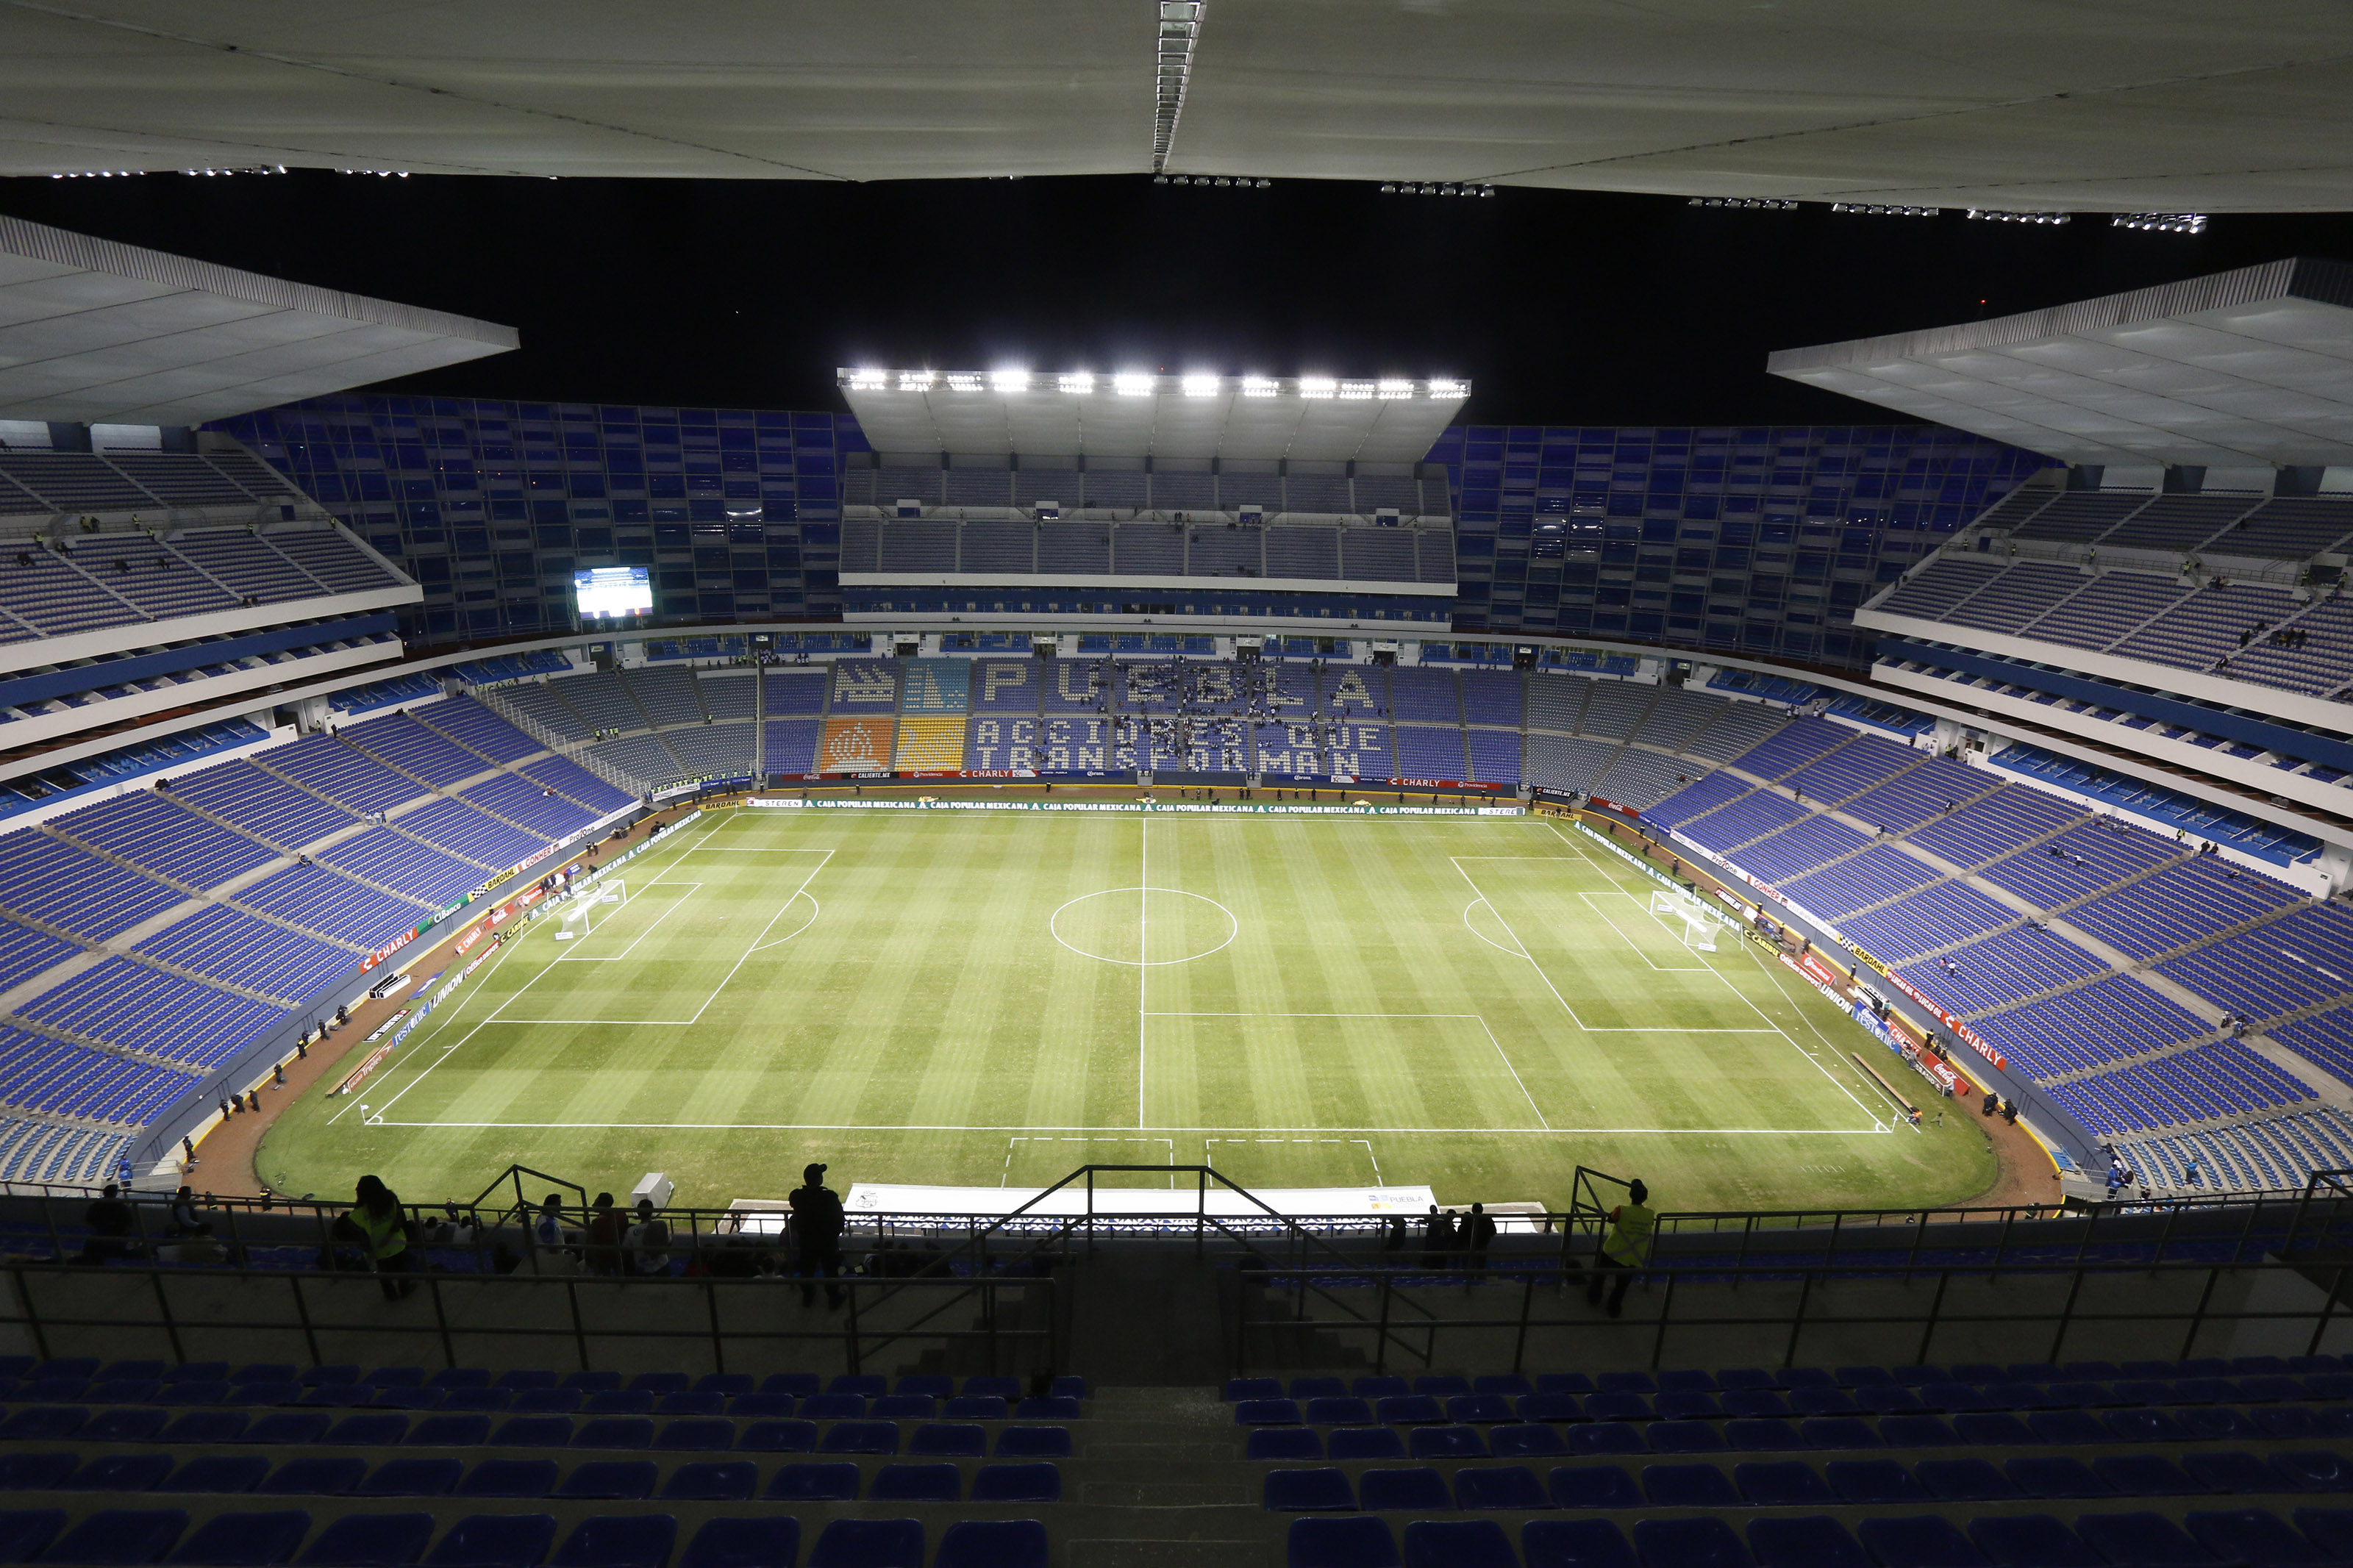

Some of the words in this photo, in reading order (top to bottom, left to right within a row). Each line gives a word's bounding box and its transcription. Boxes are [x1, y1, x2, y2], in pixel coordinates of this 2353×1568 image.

[985, 663, 1374, 708] PUEBLA
[1403, 778, 1440, 787] CHARLY
[1543, 788, 1571, 798] CALIENTE.MX
[706, 801, 740, 809] BARDAHL
[817, 800, 835, 809] CAJA
[837, 800, 873, 809] POPULAR
[930, 801, 949, 809] CAJA
[950, 801, 985, 809] POPULAR
[986, 802, 1029, 810] MEXICANA
[1043, 803, 1062, 811] CAJA
[1063, 803, 1099, 811] POPULAR
[1099, 803, 1141, 812] MEXICANA
[1156, 804, 1175, 812] CAJA
[1176, 804, 1213, 812] POPULAR
[1213, 805, 1254, 813] MEXICANA
[1269, 806, 1287, 814] CAJA
[1288, 806, 1324, 814] POPULAR
[1324, 806, 1365, 815] MEXICANA
[1434, 807, 1476, 815] MEXICANA
[1541, 809, 1574, 819] BARAHL
[650, 826, 674, 845] POPULAR
[674, 810, 701, 832] MEXICANA
[526, 847, 551, 867] GONHER
[1593, 831, 1618, 853] POPULAR
[1617, 845, 1646, 872] MEXICANA
[488, 867, 515, 889] BARDAHL
[561, 876, 593, 901] PPULAR
[593, 854, 626, 881] MEXICANA
[1754, 879, 1780, 901] GONHER
[1671, 882, 1702, 907] POPULAR
[1702, 901, 1740, 932] MEXICANA
[376, 928, 413, 962] CHARLY
[463, 926, 482, 948] CHARLY
[466, 956, 482, 975] Office
[482, 941, 500, 960] DEPOT
[1855, 948, 1885, 974] BARDAHL
[1779, 953, 1800, 971] Office
[1799, 967, 1820, 987] DEPOT
[432, 969, 464, 1009] UNION
[1891, 974, 1905, 990] LUCAS
[1904, 985, 1914, 995] OIL
[1821, 984, 1852, 1014] UNION
[1918, 994, 1934, 1012] LUCAS
[1932, 1006, 1943, 1018] OIL
[1958, 1025, 2002, 1066] CHARLY
[363, 1054, 382, 1076] Triples
